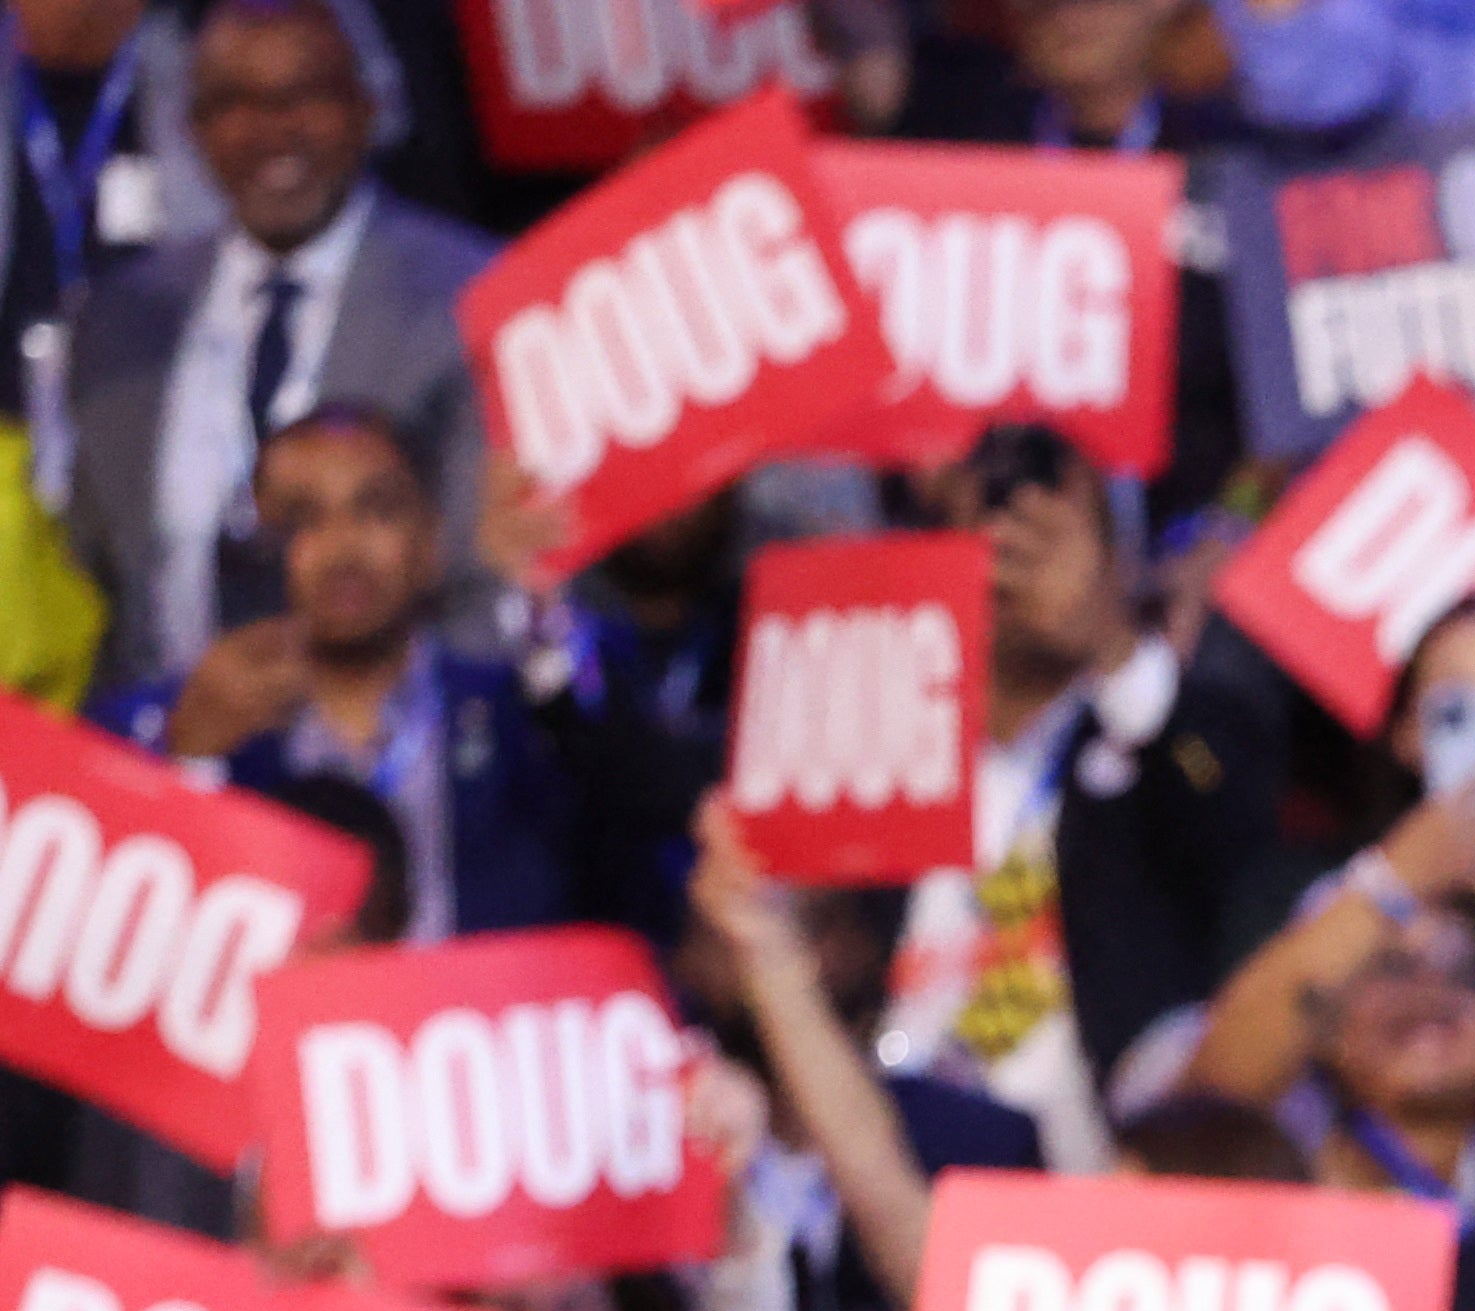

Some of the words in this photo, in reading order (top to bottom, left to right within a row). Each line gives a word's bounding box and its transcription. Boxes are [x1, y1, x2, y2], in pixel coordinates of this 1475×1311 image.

[494, 170, 848, 490] DOUG
[733, 600, 963, 813] DOUG
[297, 990, 685, 1228] DOUG
